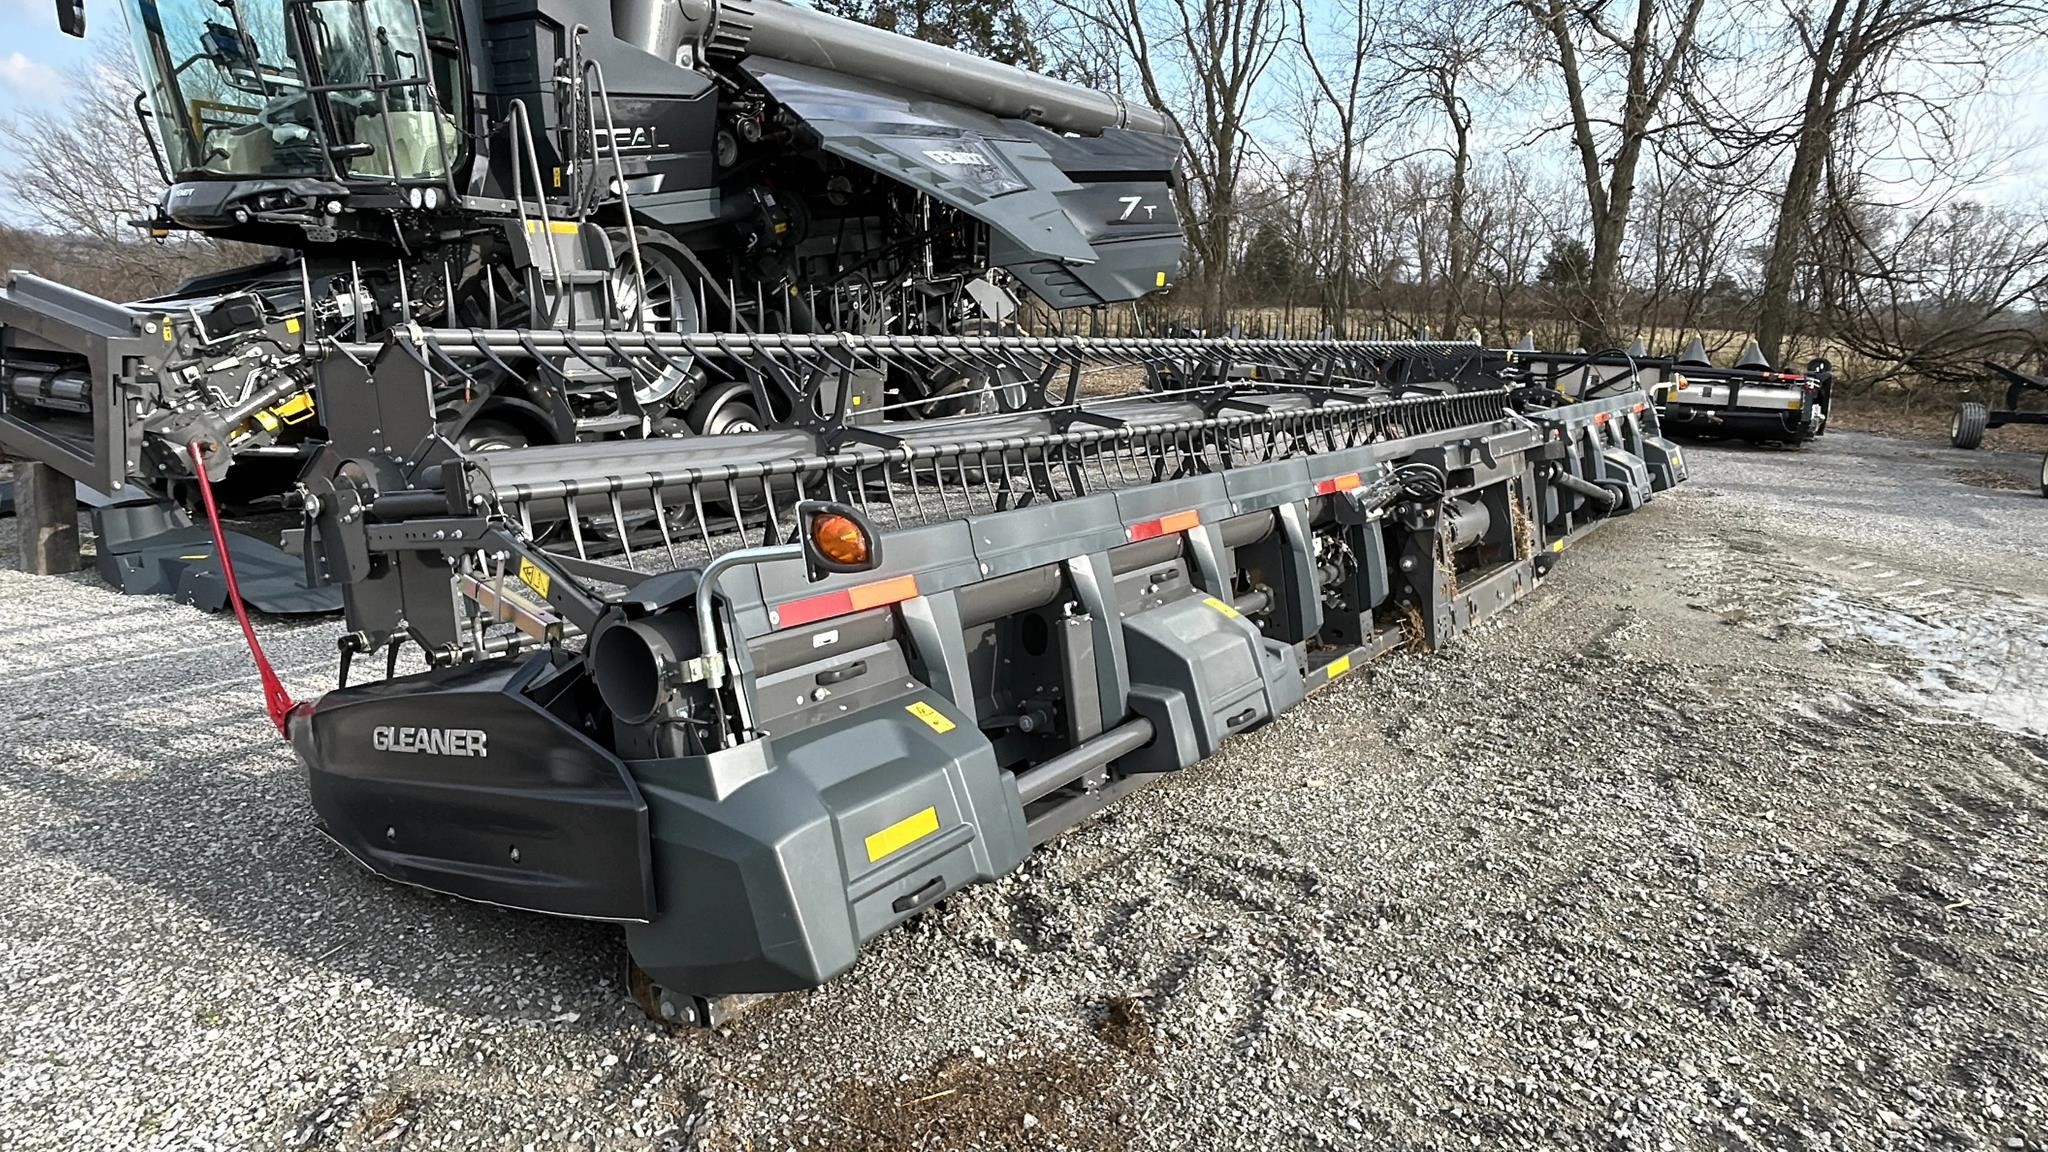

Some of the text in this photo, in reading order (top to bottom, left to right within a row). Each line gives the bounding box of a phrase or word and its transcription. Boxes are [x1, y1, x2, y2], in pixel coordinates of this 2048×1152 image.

[585, 127, 670, 153] DEAL
[1118, 196, 1157, 220] 7 T
[373, 726, 487, 758] GLEANER
